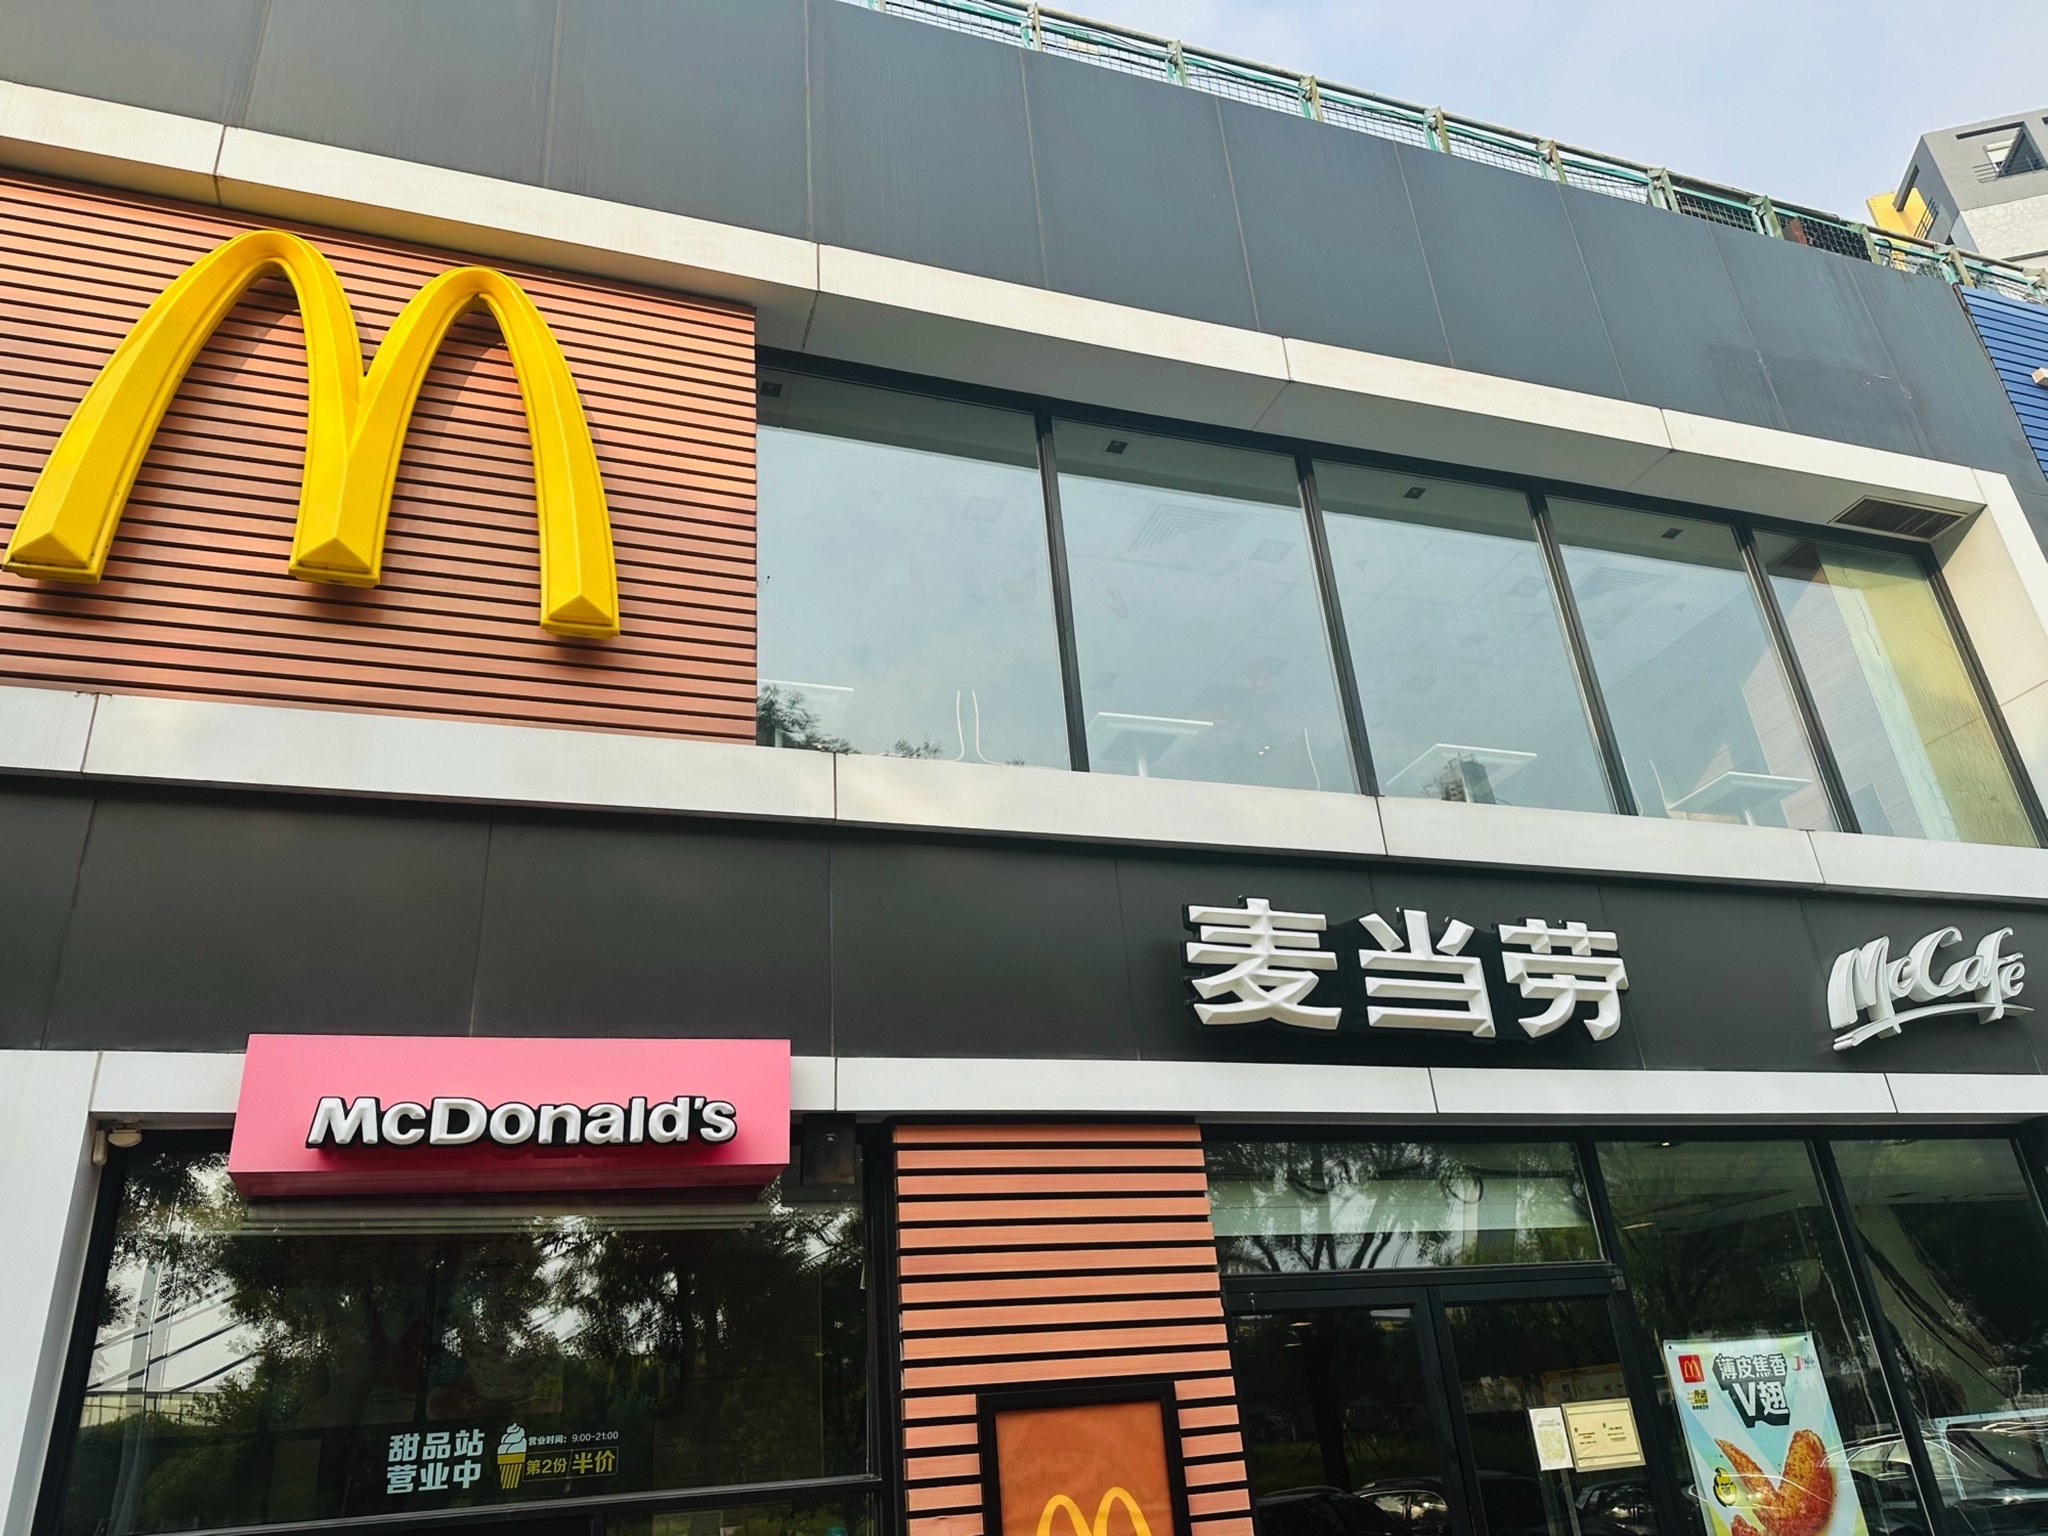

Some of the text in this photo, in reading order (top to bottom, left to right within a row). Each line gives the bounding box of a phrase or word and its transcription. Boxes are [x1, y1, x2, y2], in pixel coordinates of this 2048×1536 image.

[1186, 897, 1629, 1041] 麦当劳
[1827, 926, 2026, 1040] McCafé
[306, 1096, 738, 1146] McDonald's
[1716, 1354, 1787, 1380] 薄皮焦香
[1731, 1380, 1790, 1417] V翅
[388, 1428, 486, 1462] 甜品站
[571, 1431, 619, 1443] 9:00-21:00
[386, 1459, 482, 1494] 营业中
[526, 1449, 616, 1475] 第2份 半价
